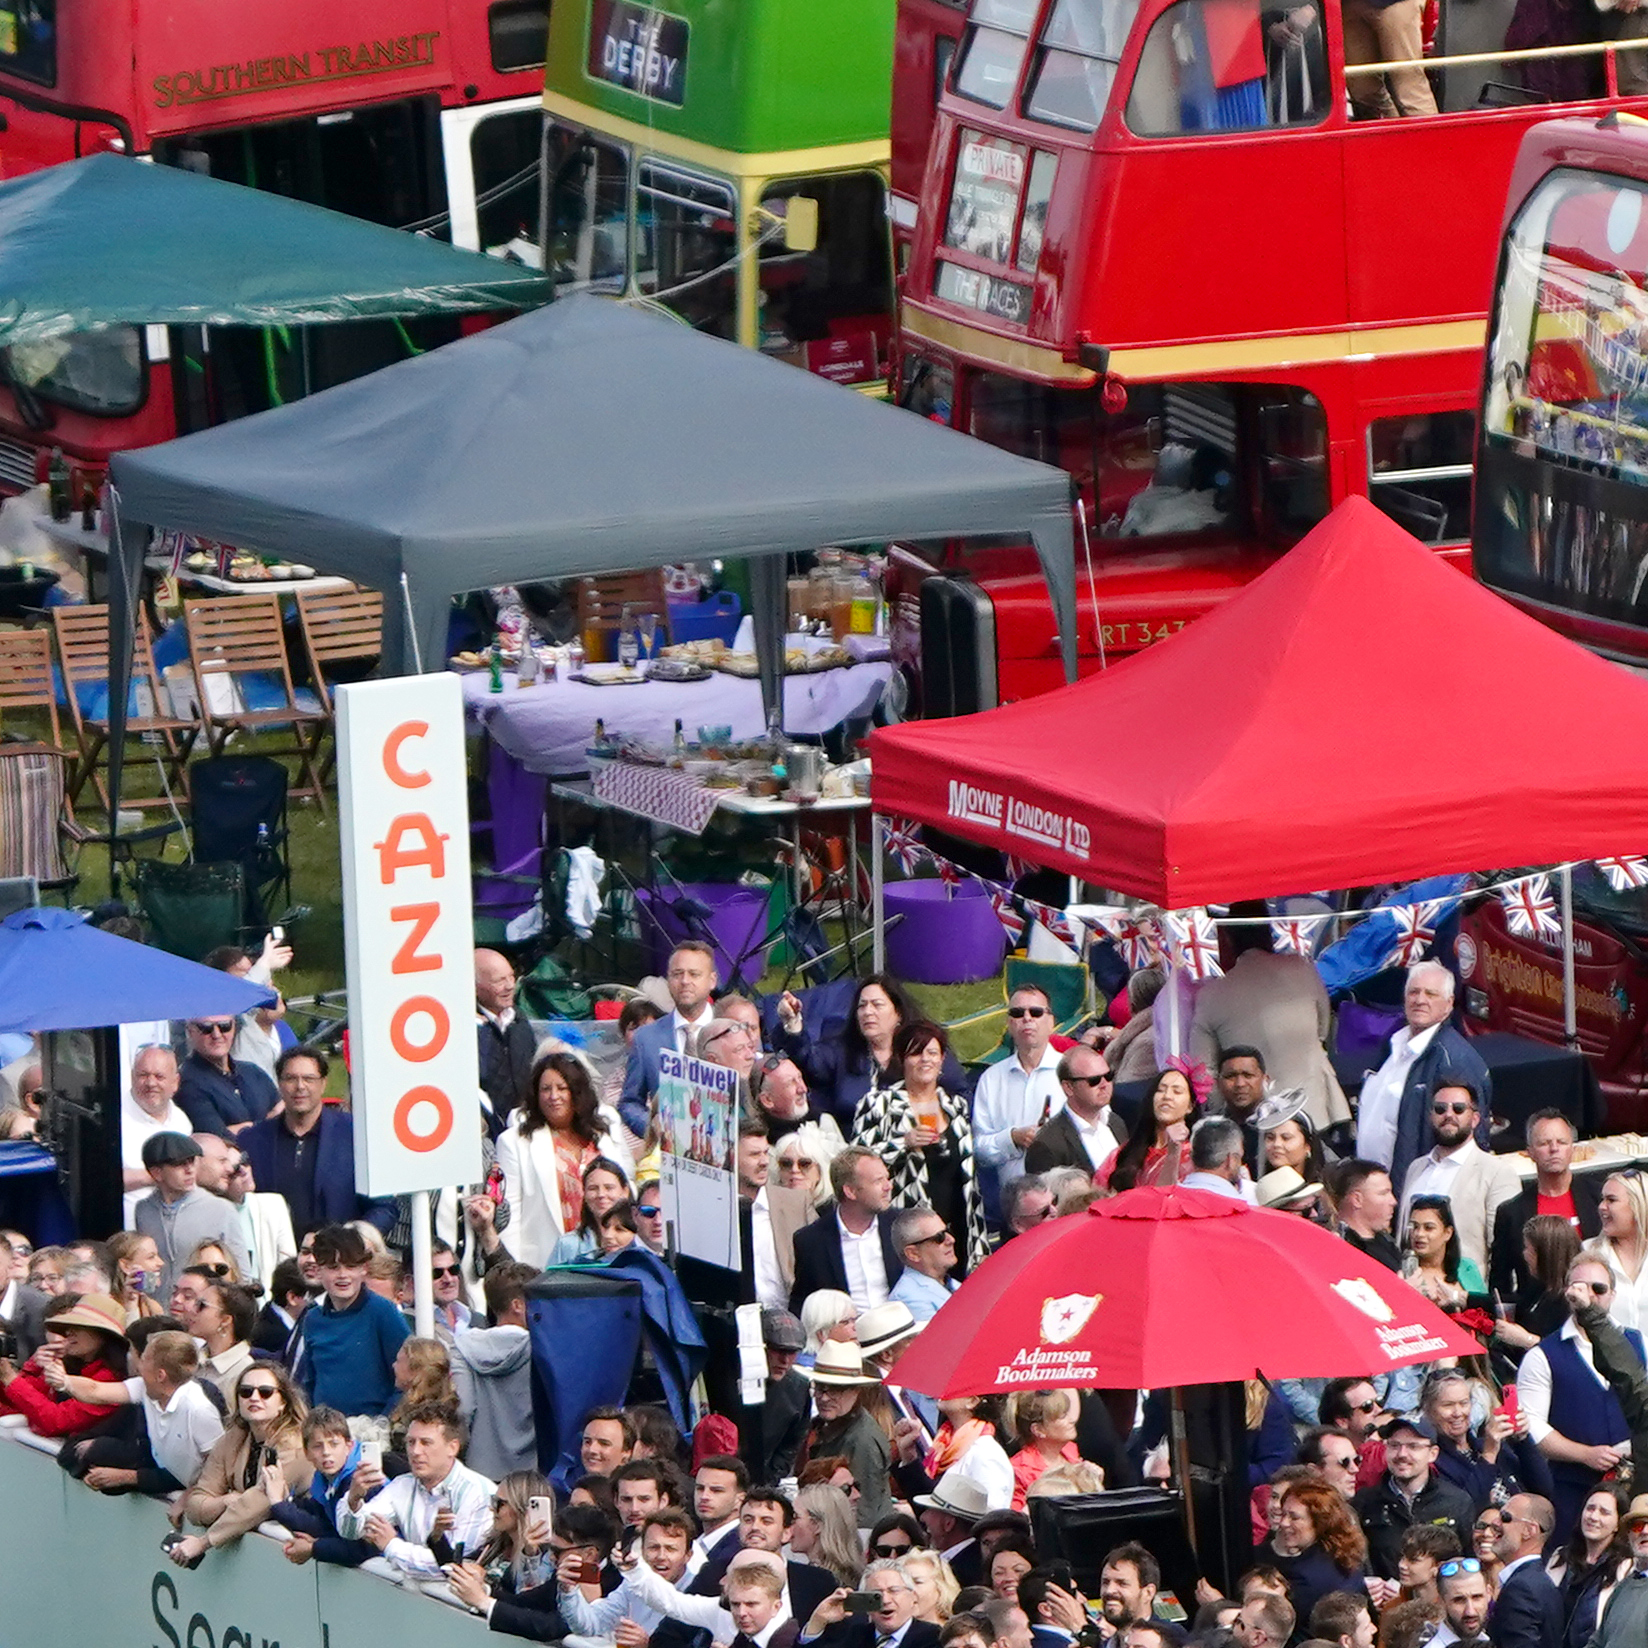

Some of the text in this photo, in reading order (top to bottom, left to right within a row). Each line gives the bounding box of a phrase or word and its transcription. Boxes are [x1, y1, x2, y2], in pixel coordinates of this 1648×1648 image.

[153, 31, 440, 107] SOUTHERN TRANSIT
[603, 34, 679, 89] DERBY
[969, 147, 1018, 179] PRIVATE
[1101, 624, 1131, 644] RT
[947, 780, 1091, 853] MOYNE LONDON LTD
[372, 719, 454, 1154] CAZOO
[1375, 1322, 1429, 1343] Adamson
[1011, 1347, 1093, 1367] Adamson
[1378, 1336, 1448, 1361] Bookmakers
[994, 1363, 1098, 1385] Bookmakers
